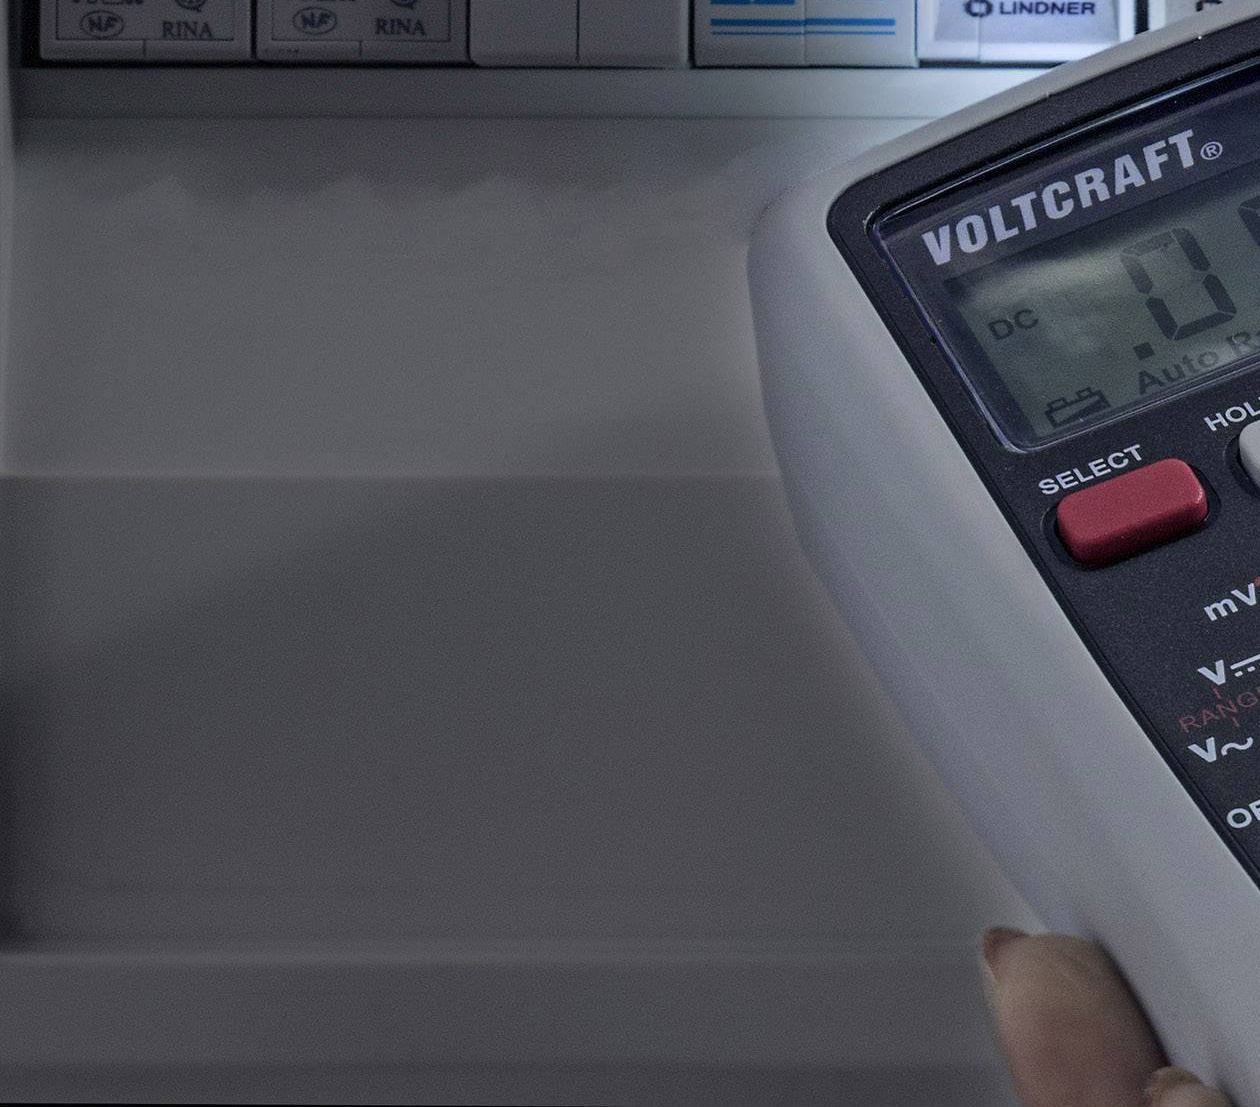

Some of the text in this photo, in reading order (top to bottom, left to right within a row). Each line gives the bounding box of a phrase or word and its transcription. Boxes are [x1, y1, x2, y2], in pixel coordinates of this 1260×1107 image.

[1000, 1, 1096, 15] LINDNER
[162, 21, 213, 38] RINA
[375, 18, 427, 36] RINA
[987, 308, 1039, 341] DC
[1136, 350, 1218, 396] Auto
[1038, 444, 1143, 496] SELECT
[1203, 582, 1257, 621] mV
